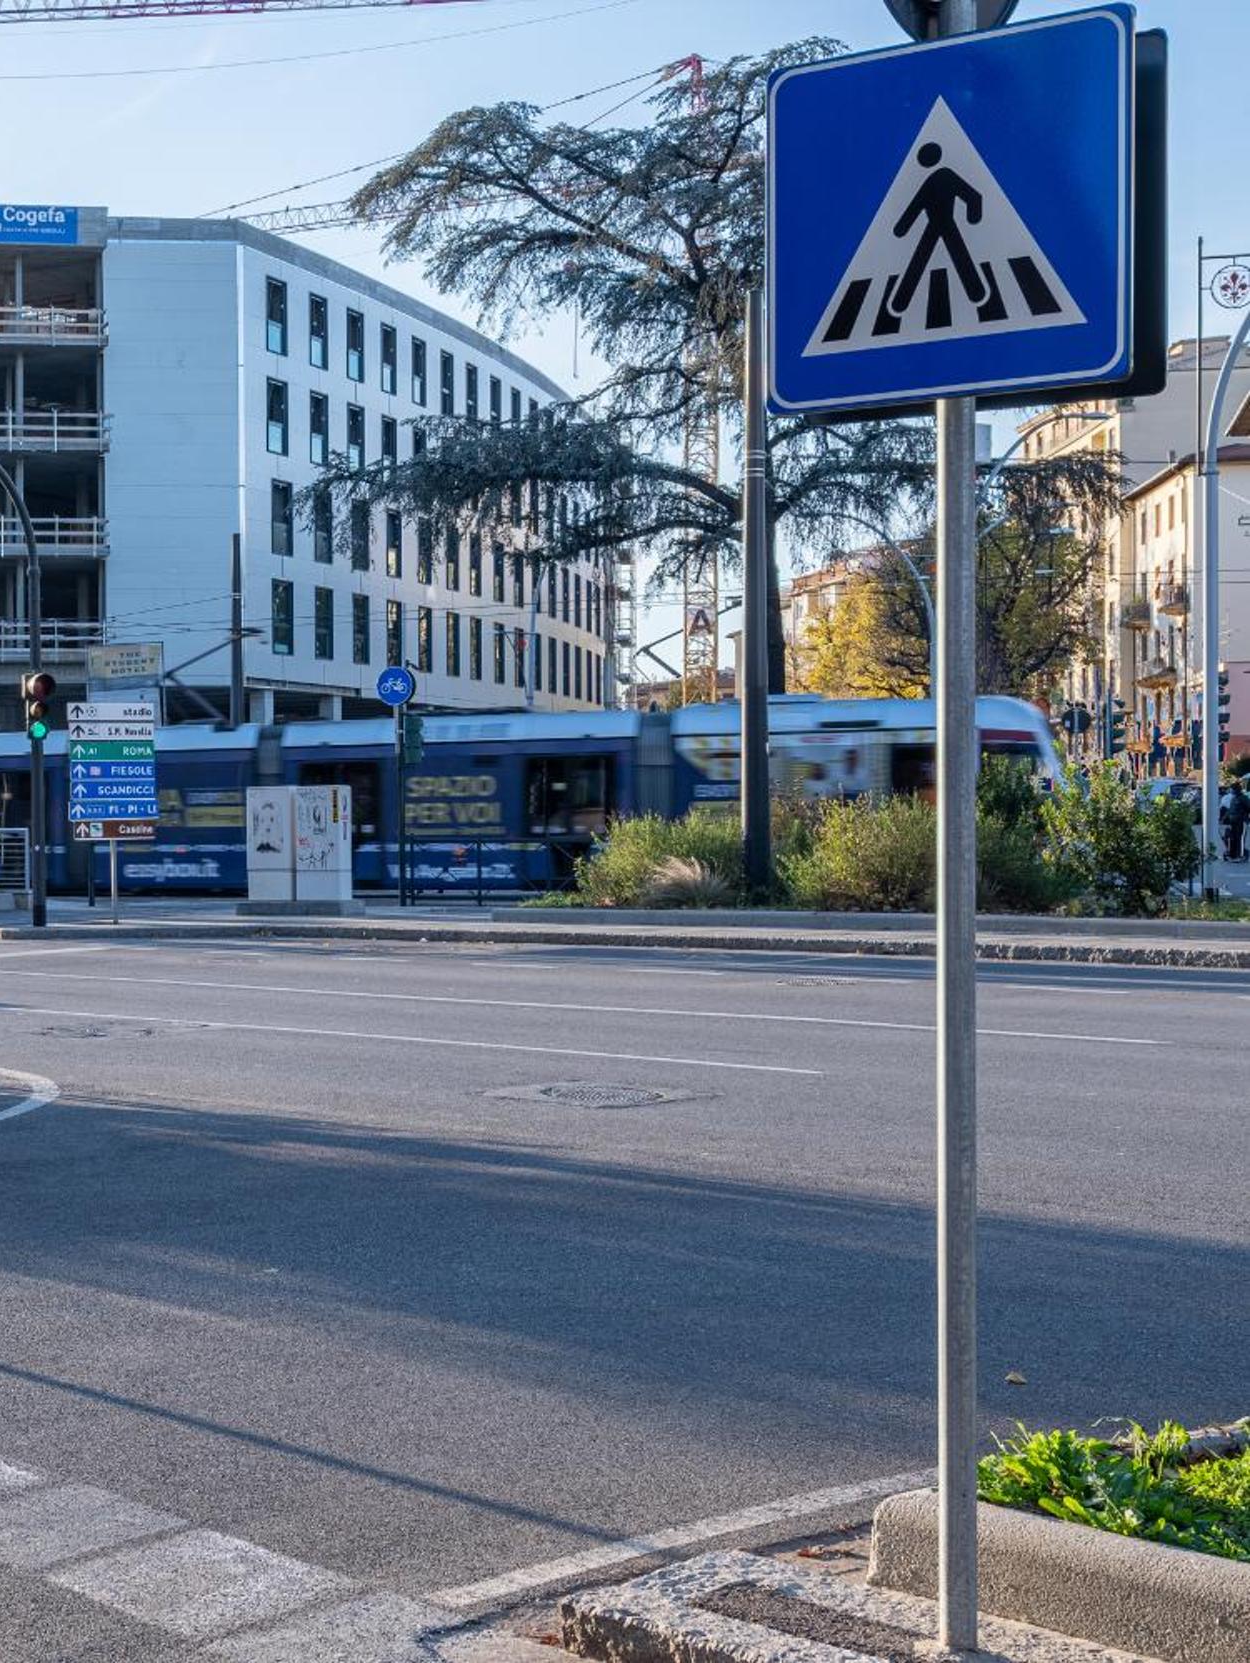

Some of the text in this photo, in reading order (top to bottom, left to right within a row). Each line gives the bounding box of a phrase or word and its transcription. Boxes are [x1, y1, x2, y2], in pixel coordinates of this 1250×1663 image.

[3, 206, 66, 226] Cogefa
[123, 707, 153, 716] stadio
[123, 746, 153, 756] ROMA
[111, 766, 153, 776] FIESOLE
[98, 785, 155, 796] SCANDICCI
